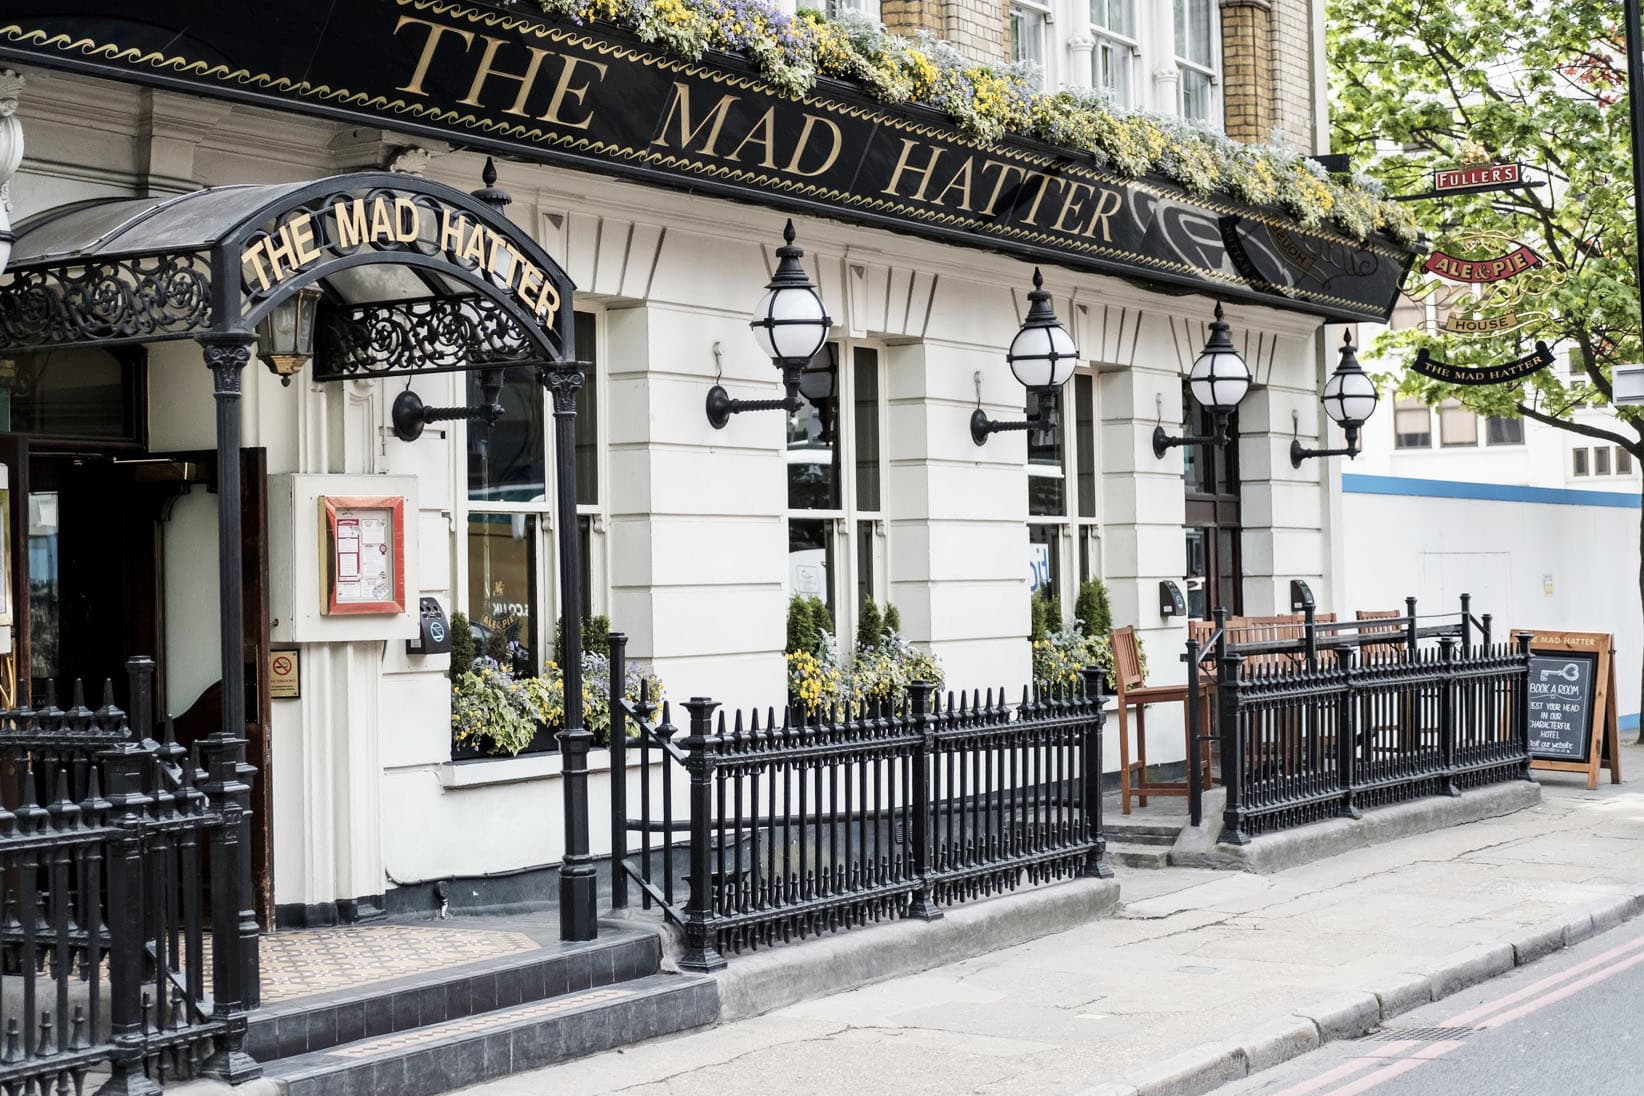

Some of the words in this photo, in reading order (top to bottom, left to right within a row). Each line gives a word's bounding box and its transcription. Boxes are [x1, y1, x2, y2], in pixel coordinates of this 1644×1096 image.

[395, 15, 607, 130] THE
[651, 82, 842, 177] MAD
[882, 138, 1123, 242] HATTER
[1440, 168, 1513, 187] FULLER'S
[241, 213, 321, 291] THE
[335, 197, 419, 248] MAD
[440, 209, 560, 330] HATTER
[1455, 317, 1508, 331] HOUSE
[1425, 362, 1450, 377] THE
[1454, 371, 1484, 380] MAD
[1490, 356, 1543, 379] HATTER
[1564, 637, 1594, 646] HATTER
[1529, 682, 1550, 693] BOOK
[1551, 683, 1556, 694] A
[1558, 684, 1579, 695] ROOM
[1546, 703, 1561, 711] YOUR
[1563, 704, 1580, 712] HEAD
[1550, 712, 1562, 720] OUR
[1541, 730, 1560, 739] HOTEL
